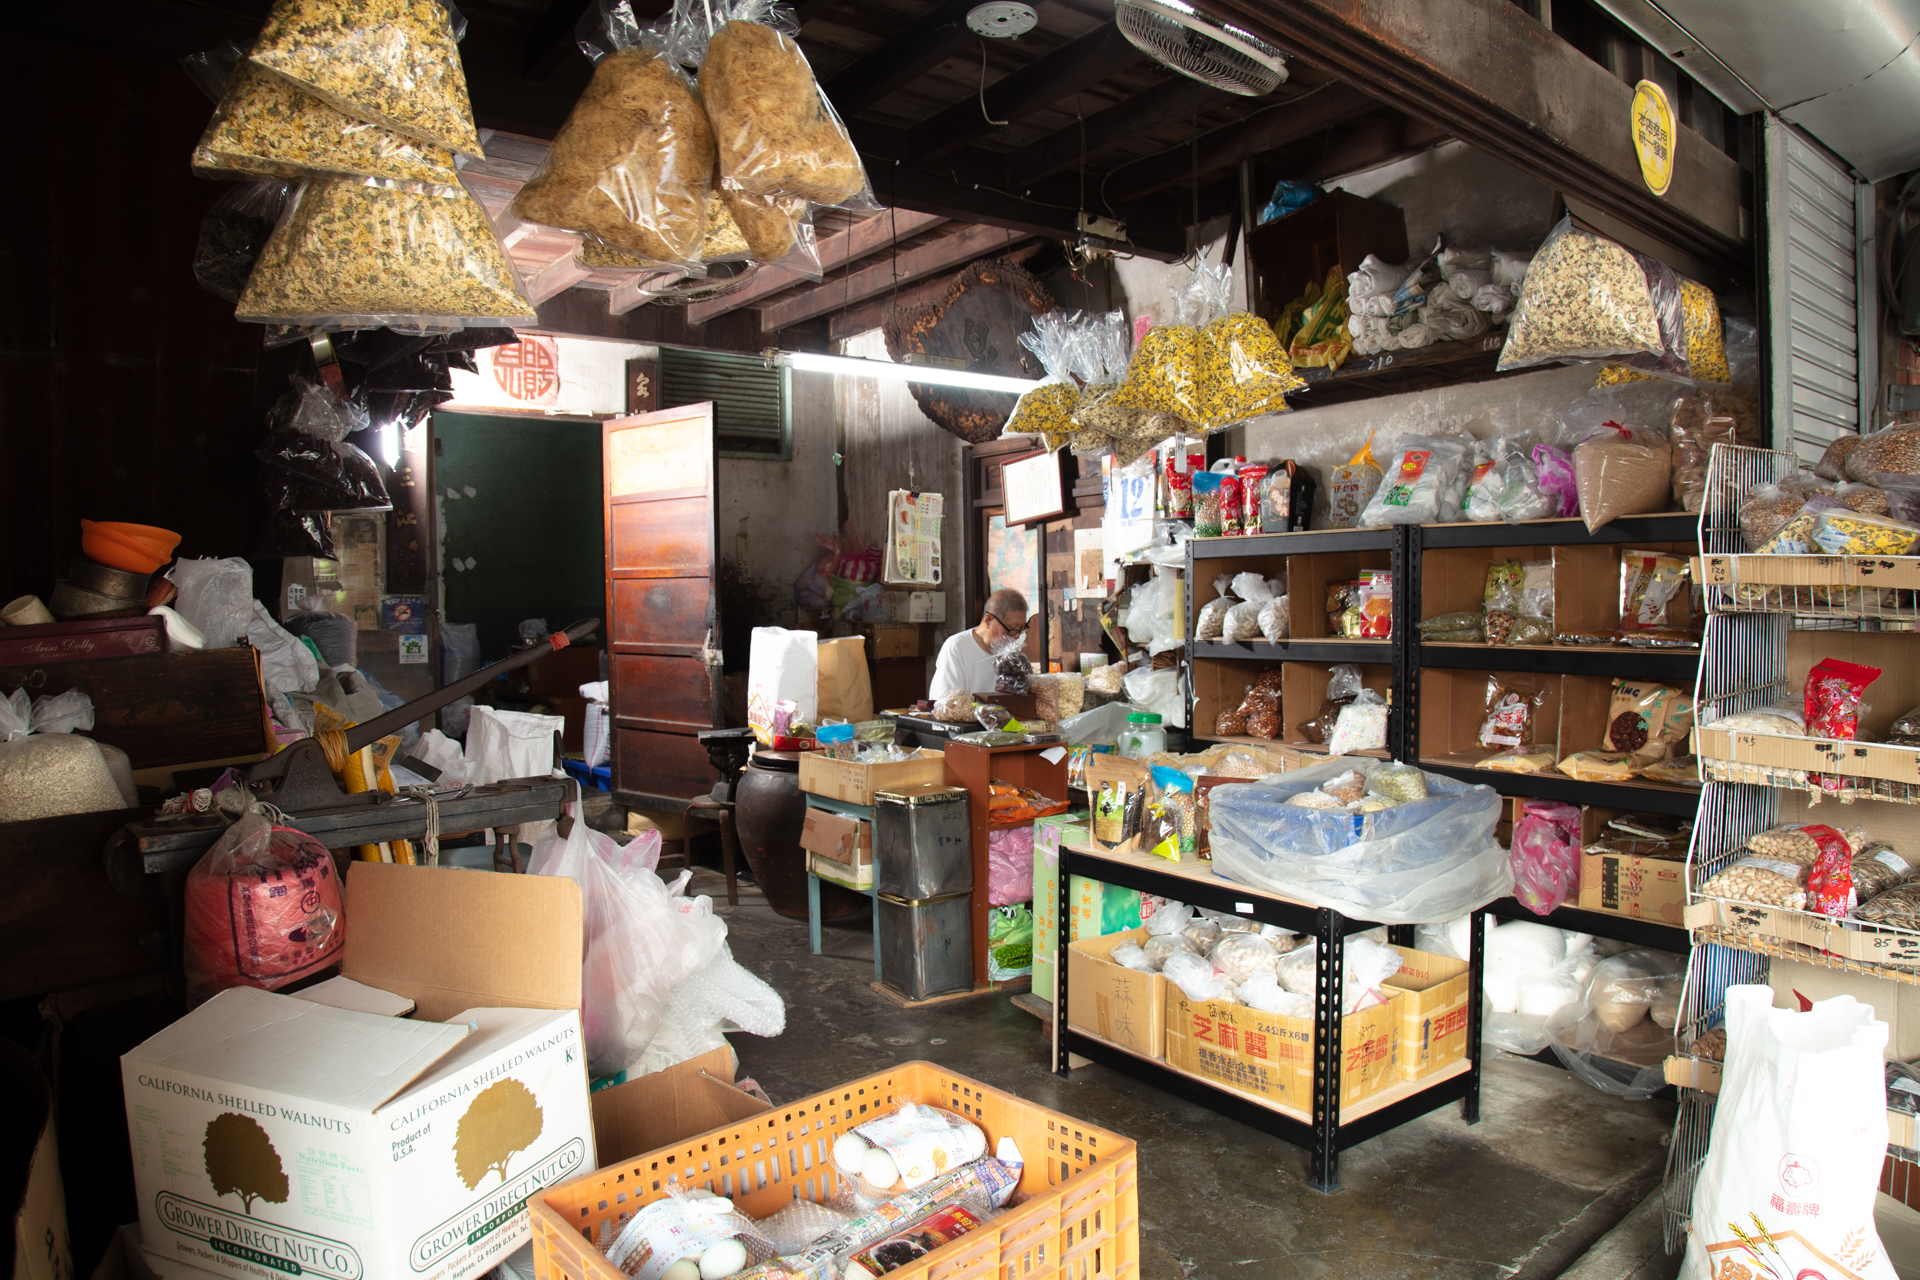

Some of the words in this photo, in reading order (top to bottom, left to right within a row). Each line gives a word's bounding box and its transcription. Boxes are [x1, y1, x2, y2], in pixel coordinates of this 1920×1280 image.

[1120, 476, 1144, 519] 12
[21, 641, 59, 654] Arisa
[60, 638, 96, 653] Dolly
[1873, 938, 1892, 948] 85
[1192, 1013, 1268, 1060] 芝麻醬
[390, 1083, 471, 1131] CALIFORNIA
[472, 1054, 524, 1088] SHELLED
[524, 1026, 575, 1059] WALNUTS
[138, 1074, 215, 1103] CALIFORNIA
[217, 1093, 277, 1117] SHELLED
[280, 1107, 351, 1135] WALNUTS
[391, 1129, 422, 1152] Product
[422, 1122, 431, 1135] of
[393, 1144, 416, 1162] U.S.A.
[298, 1152, 339, 1168] Nutrition
[340, 1162, 364, 1174] Facts
[1770, 1192, 1820, 1219] 福壽牌
[176, 1241, 197, 1257] Growers,
[197, 1248, 216, 1261] Packers
[220, 1256, 242, 1270] Shippers
[249, 1265, 269, 1280] Healthy
[213, 1239, 298, 1273] INCORPORATED
[447, 1254, 467, 1270] Packers
[473, 1236, 496, 1255] Shippers
[501, 1217, 520, 1236] Healthy
[452, 1262, 476, 1280] Hughson,
[477, 1254, 485, 1264] CA
[485, 1243, 502, 1258] 95326
